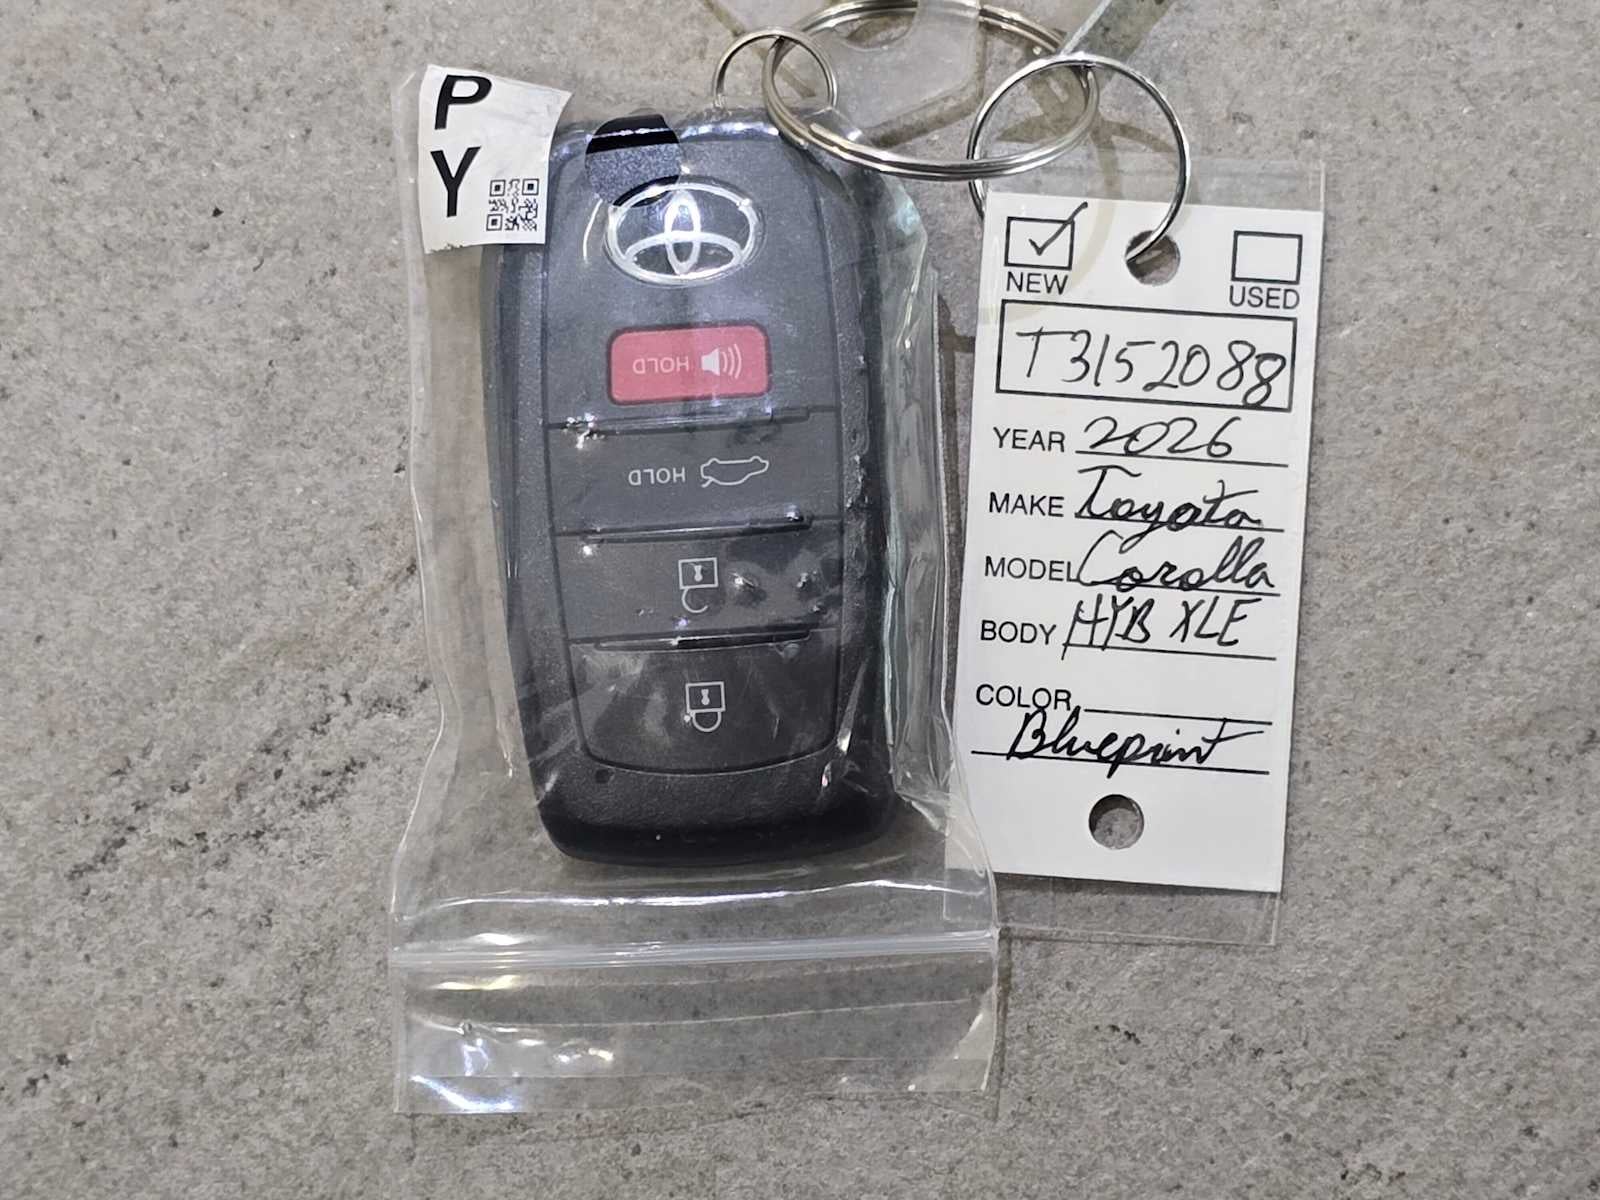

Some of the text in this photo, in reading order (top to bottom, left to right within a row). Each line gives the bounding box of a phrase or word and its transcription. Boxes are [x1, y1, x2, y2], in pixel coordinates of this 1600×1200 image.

[434, 74, 492, 130] P
[430, 146, 481, 218] Y
[1006, 271, 1068, 295] NEW
[1229, 285, 1300, 310] USED
[632, 356, 689, 374] HOLD
[1016, 327, 1287, 408] T3152088
[993, 416, 1241, 458] YEAR 2026
[628, 467, 686, 486] HOLD
[989, 492, 1065, 517] MAKE
[984, 530, 1275, 591] MODEL Corolla
[980, 593, 1262, 660] BODY HYB XLE
[976, 684, 1071, 711] COLOR
[1006, 705, 1265, 779] Blueprint
